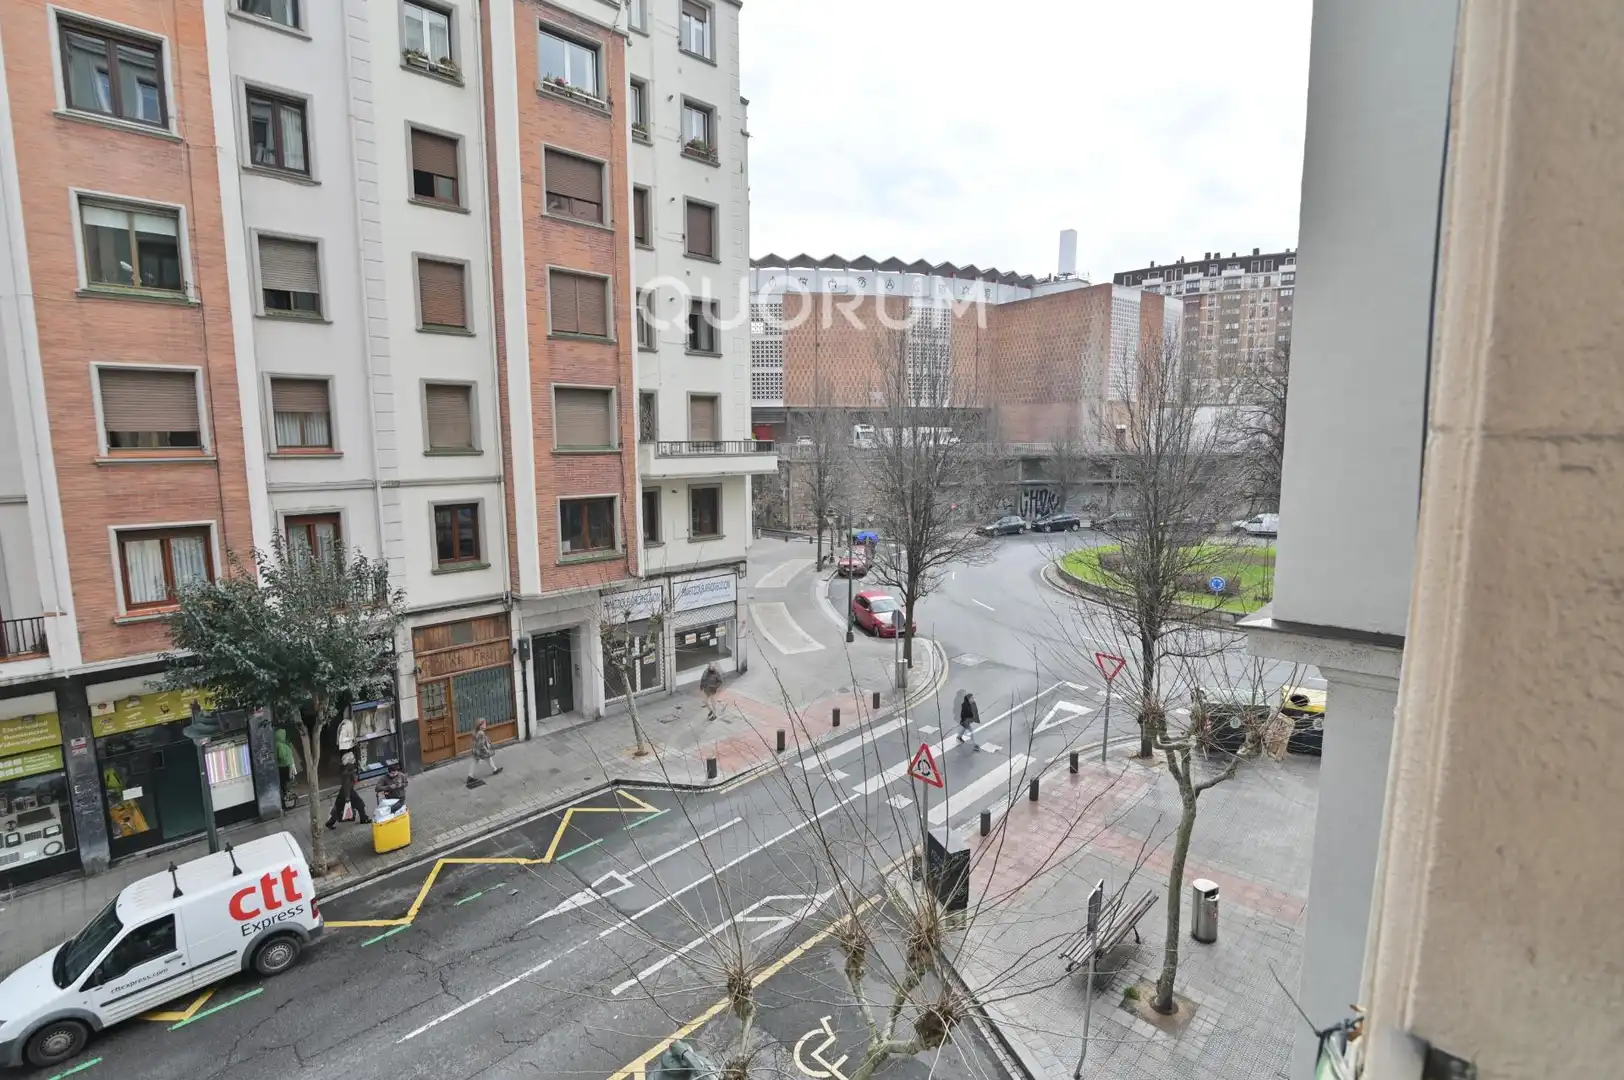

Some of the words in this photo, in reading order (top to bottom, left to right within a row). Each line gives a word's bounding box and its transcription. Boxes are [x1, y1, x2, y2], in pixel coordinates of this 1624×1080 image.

[229, 864, 303, 921] ctt
[241, 904, 304, 937] Express
[110, 967, 169, 995] cttexpress.com
